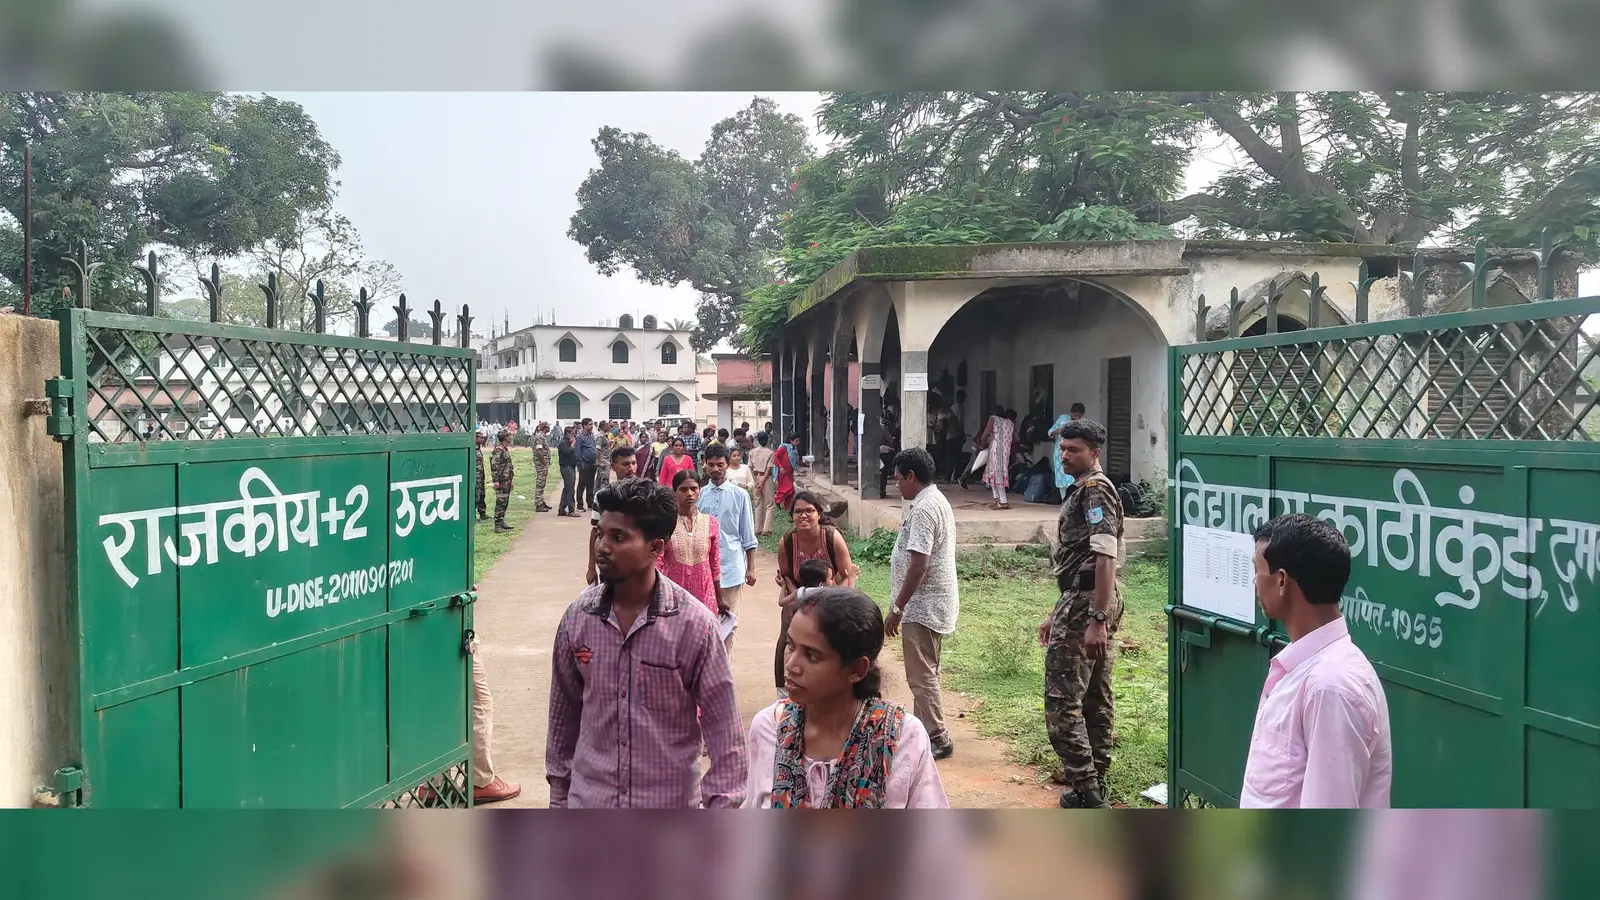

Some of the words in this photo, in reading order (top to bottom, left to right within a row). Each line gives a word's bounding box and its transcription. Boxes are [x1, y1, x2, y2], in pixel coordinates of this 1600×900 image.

[390, 475, 463, 538] उच्च
[266, 558, 414, 618] U-DISE-20110907201
[1549, 518, 1600, 612] दुम
